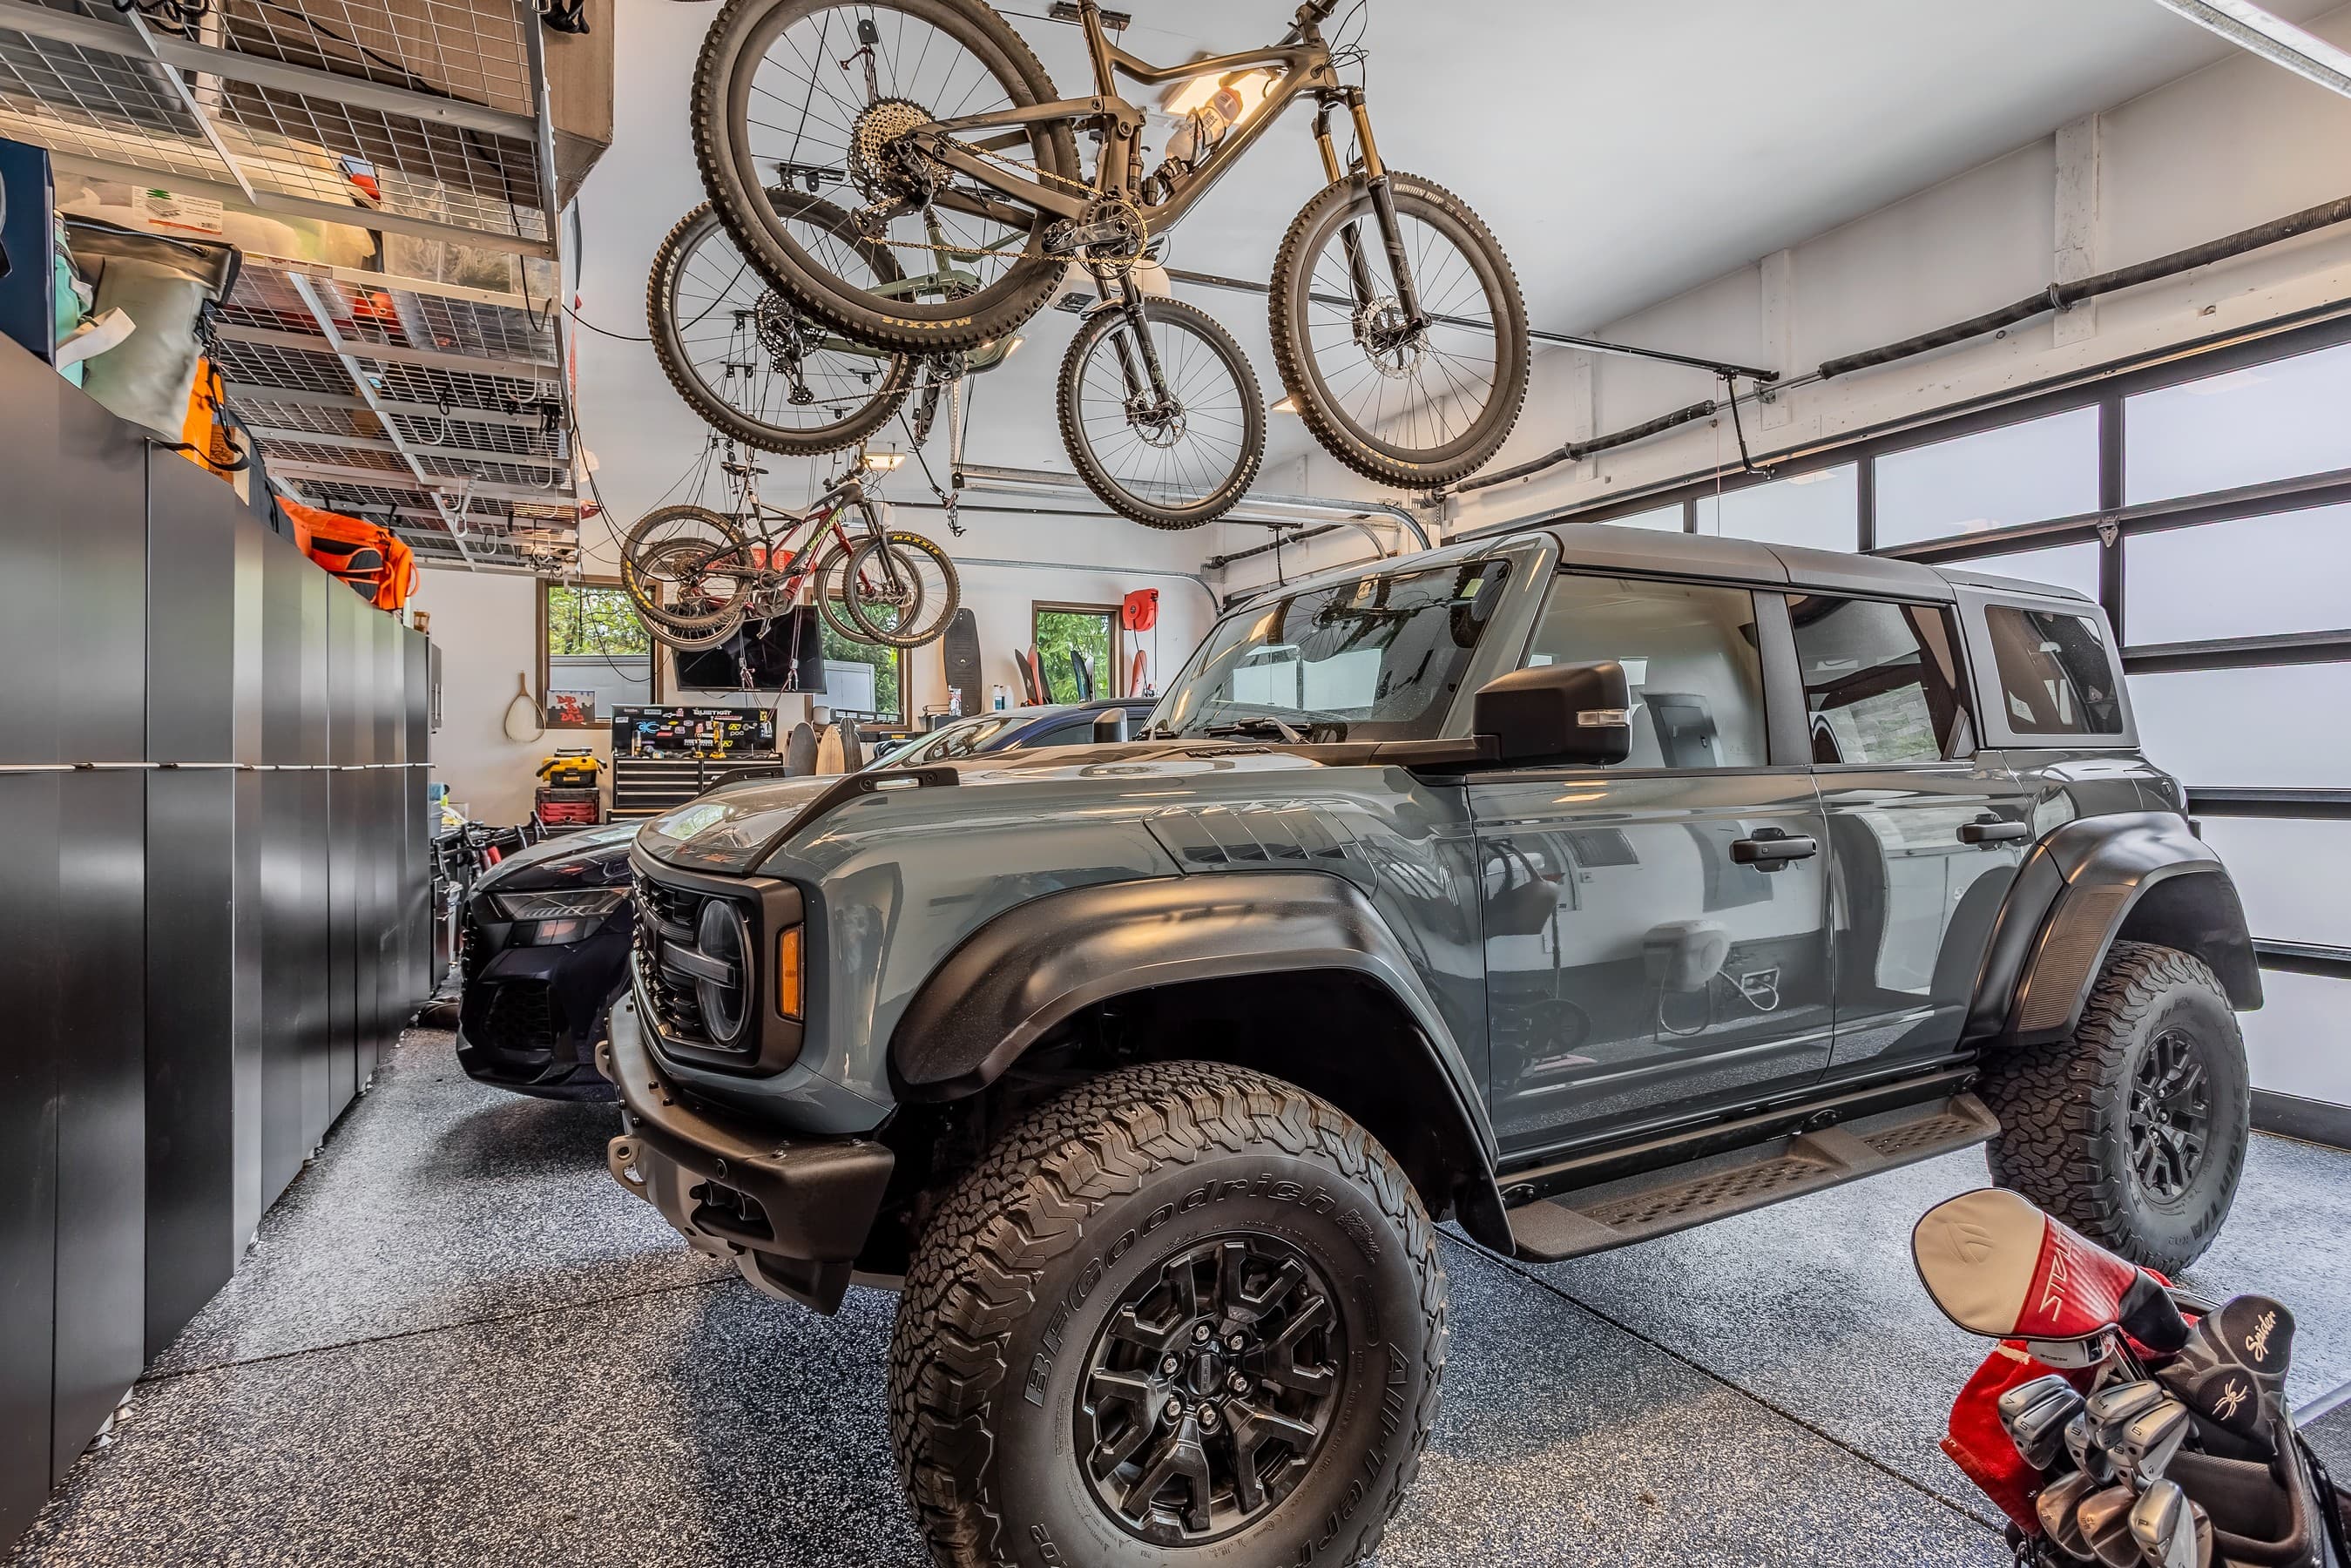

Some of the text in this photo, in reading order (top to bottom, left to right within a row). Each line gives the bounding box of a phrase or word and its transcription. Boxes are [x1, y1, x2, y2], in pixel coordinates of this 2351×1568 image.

[661, 246, 681, 313] MAXXIS
[881, 316, 972, 329] MAXXIS
[1226, 455, 1254, 498] MAXXIS
[1358, 442, 1420, 470] MAXXIS
[807, 507, 843, 551] SPECIALIZED
[892, 534, 940, 555] MAXXIS
[2190, 1200, 2219, 1240] T/A
[1023, 1173, 1337, 1409] BFGoodrich
[2038, 1221, 2073, 1322] STEALT
[2245, 1310, 2277, 1362] Spider
[1030, 1523, 1069, 1568] O2
